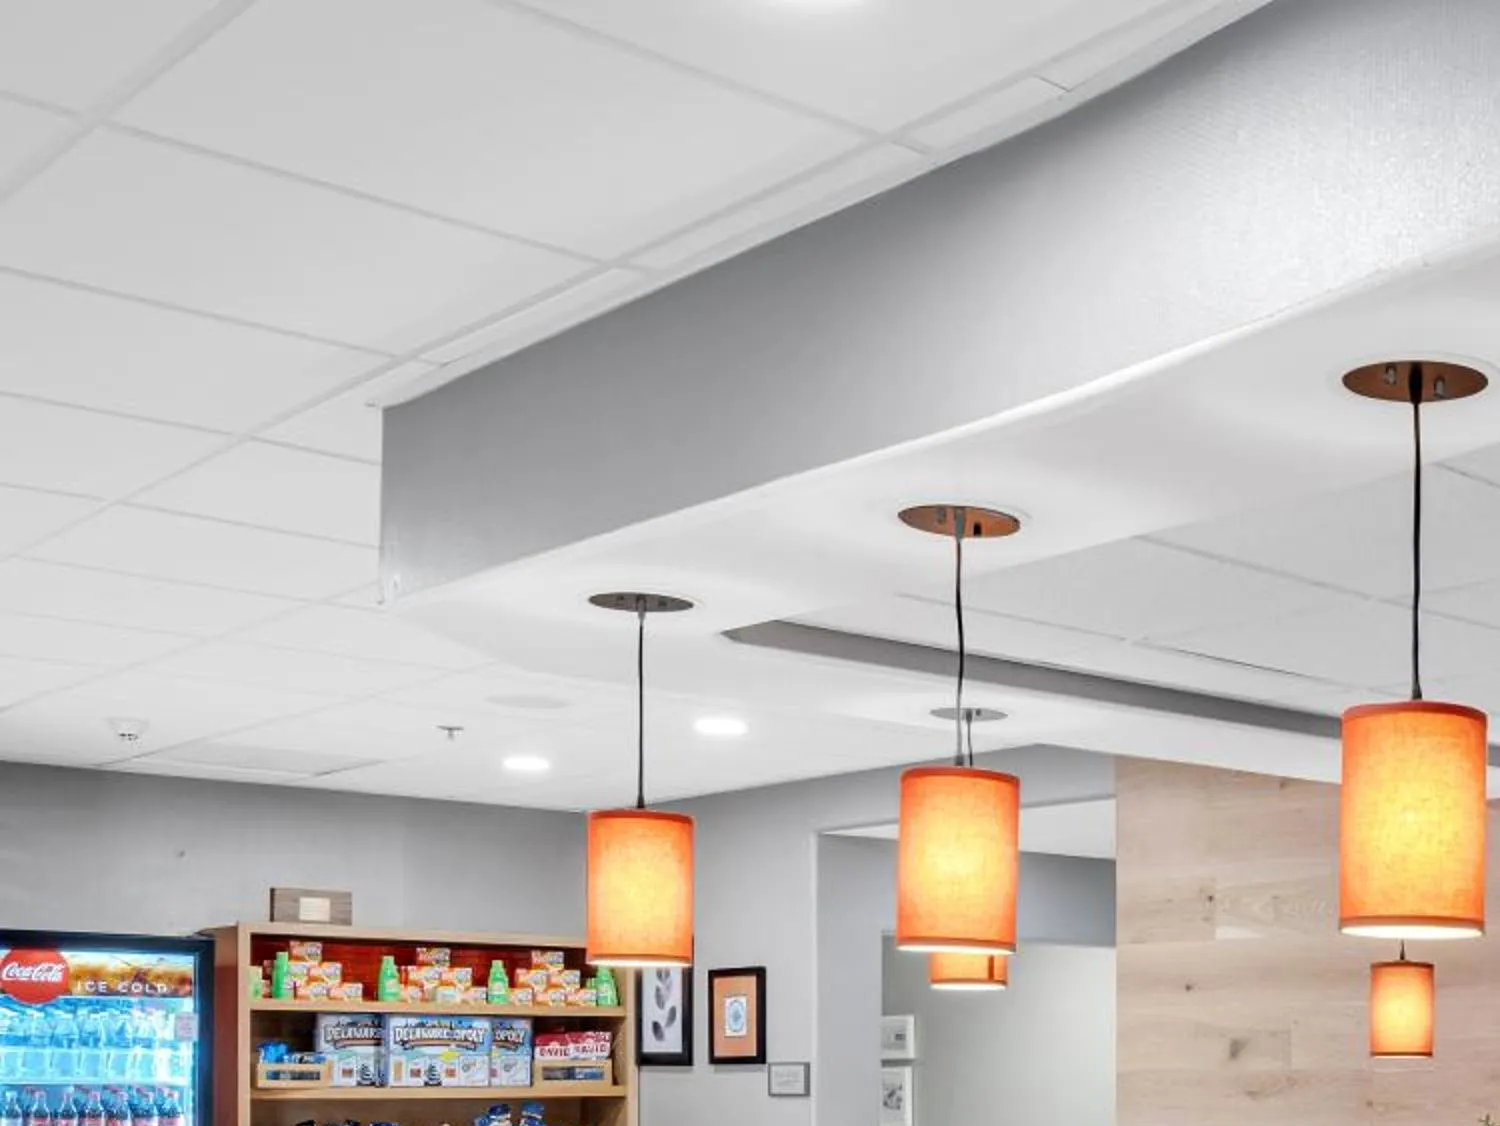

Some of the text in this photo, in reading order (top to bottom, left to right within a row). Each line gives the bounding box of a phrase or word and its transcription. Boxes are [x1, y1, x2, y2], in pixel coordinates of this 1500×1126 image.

[2, 961, 64, 982] Coca-Cola
[76, 981, 168, 993] ICE COLD
